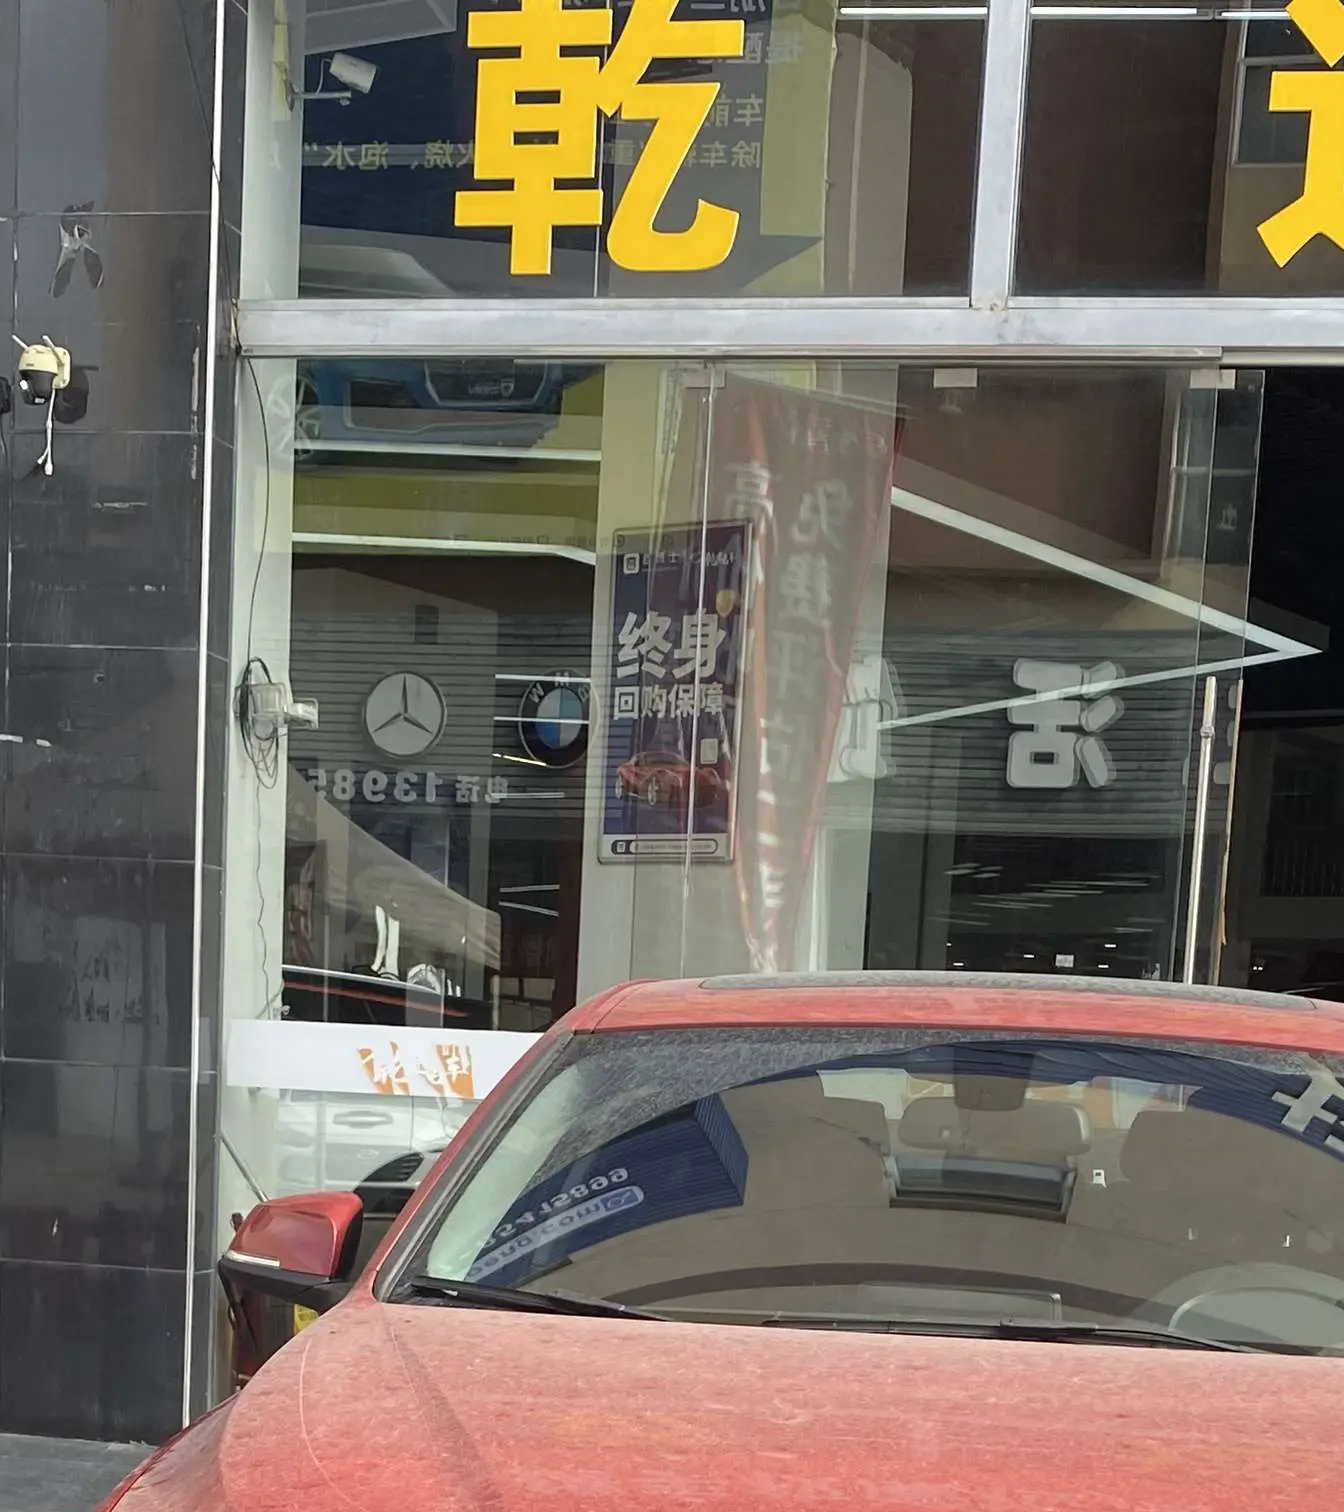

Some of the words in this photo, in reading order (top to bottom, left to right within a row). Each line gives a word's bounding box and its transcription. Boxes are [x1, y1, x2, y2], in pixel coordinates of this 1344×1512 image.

[453, 0, 746, 276] 乾
[616, 607, 728, 680] 终身
[612, 682, 725, 723] 回购保障
